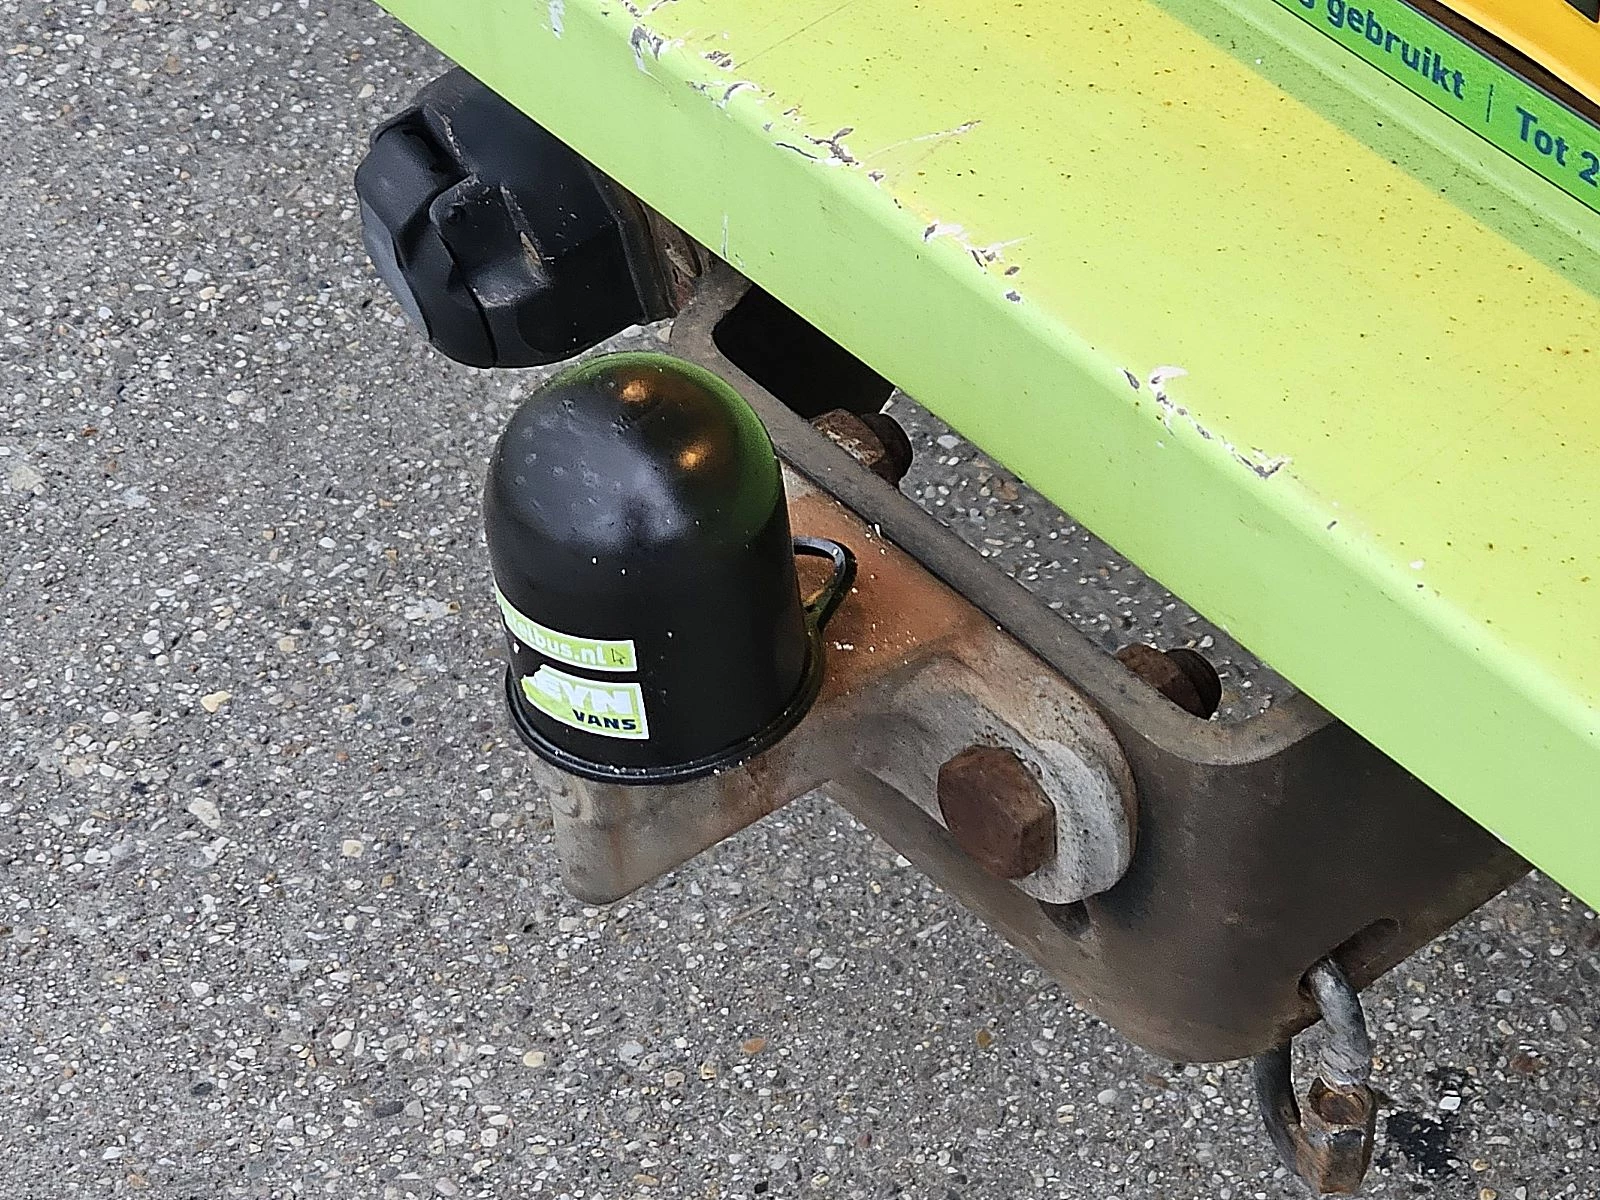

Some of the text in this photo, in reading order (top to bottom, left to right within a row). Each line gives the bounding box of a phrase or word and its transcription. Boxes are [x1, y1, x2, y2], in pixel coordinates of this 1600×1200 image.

[1327, 0, 1466, 100] gebruikt
[1516, 106, 1570, 168] Tot
[531, 671, 633, 714] EYN
[572, 709, 637, 731] VANS
